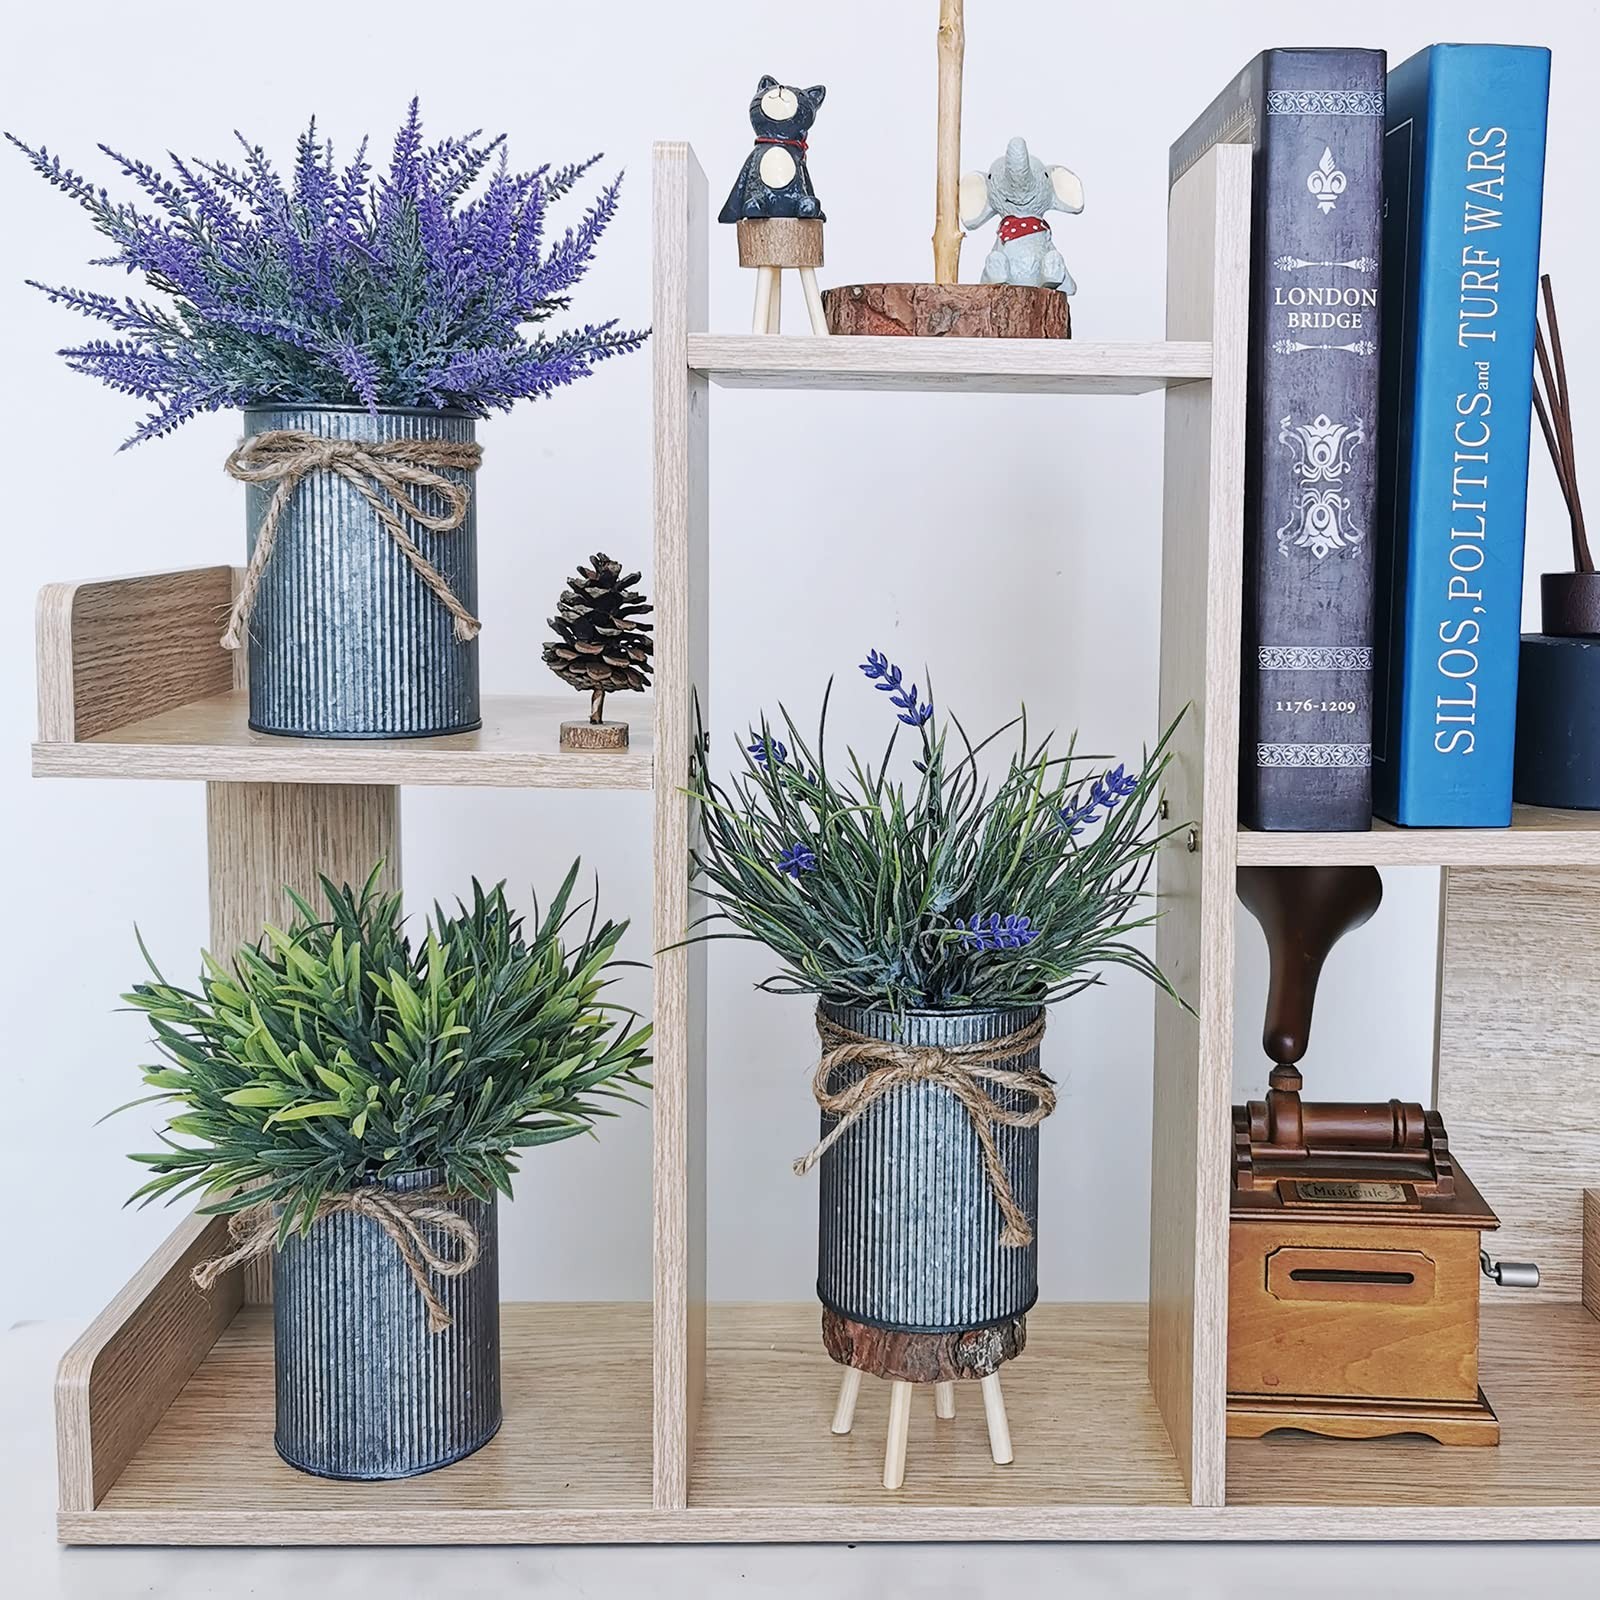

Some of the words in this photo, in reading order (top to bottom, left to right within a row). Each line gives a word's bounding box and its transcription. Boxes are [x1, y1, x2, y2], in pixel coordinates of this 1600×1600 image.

[1463, 126, 1508, 234] WARS
[1274, 287, 1378, 307] LONDON
[1458, 245, 1501, 348] TURF
[1287, 312, 1363, 329] BRIDGE
[1474, 361, 1490, 390] and
[1276, 699, 1356, 714] 1176-1209
